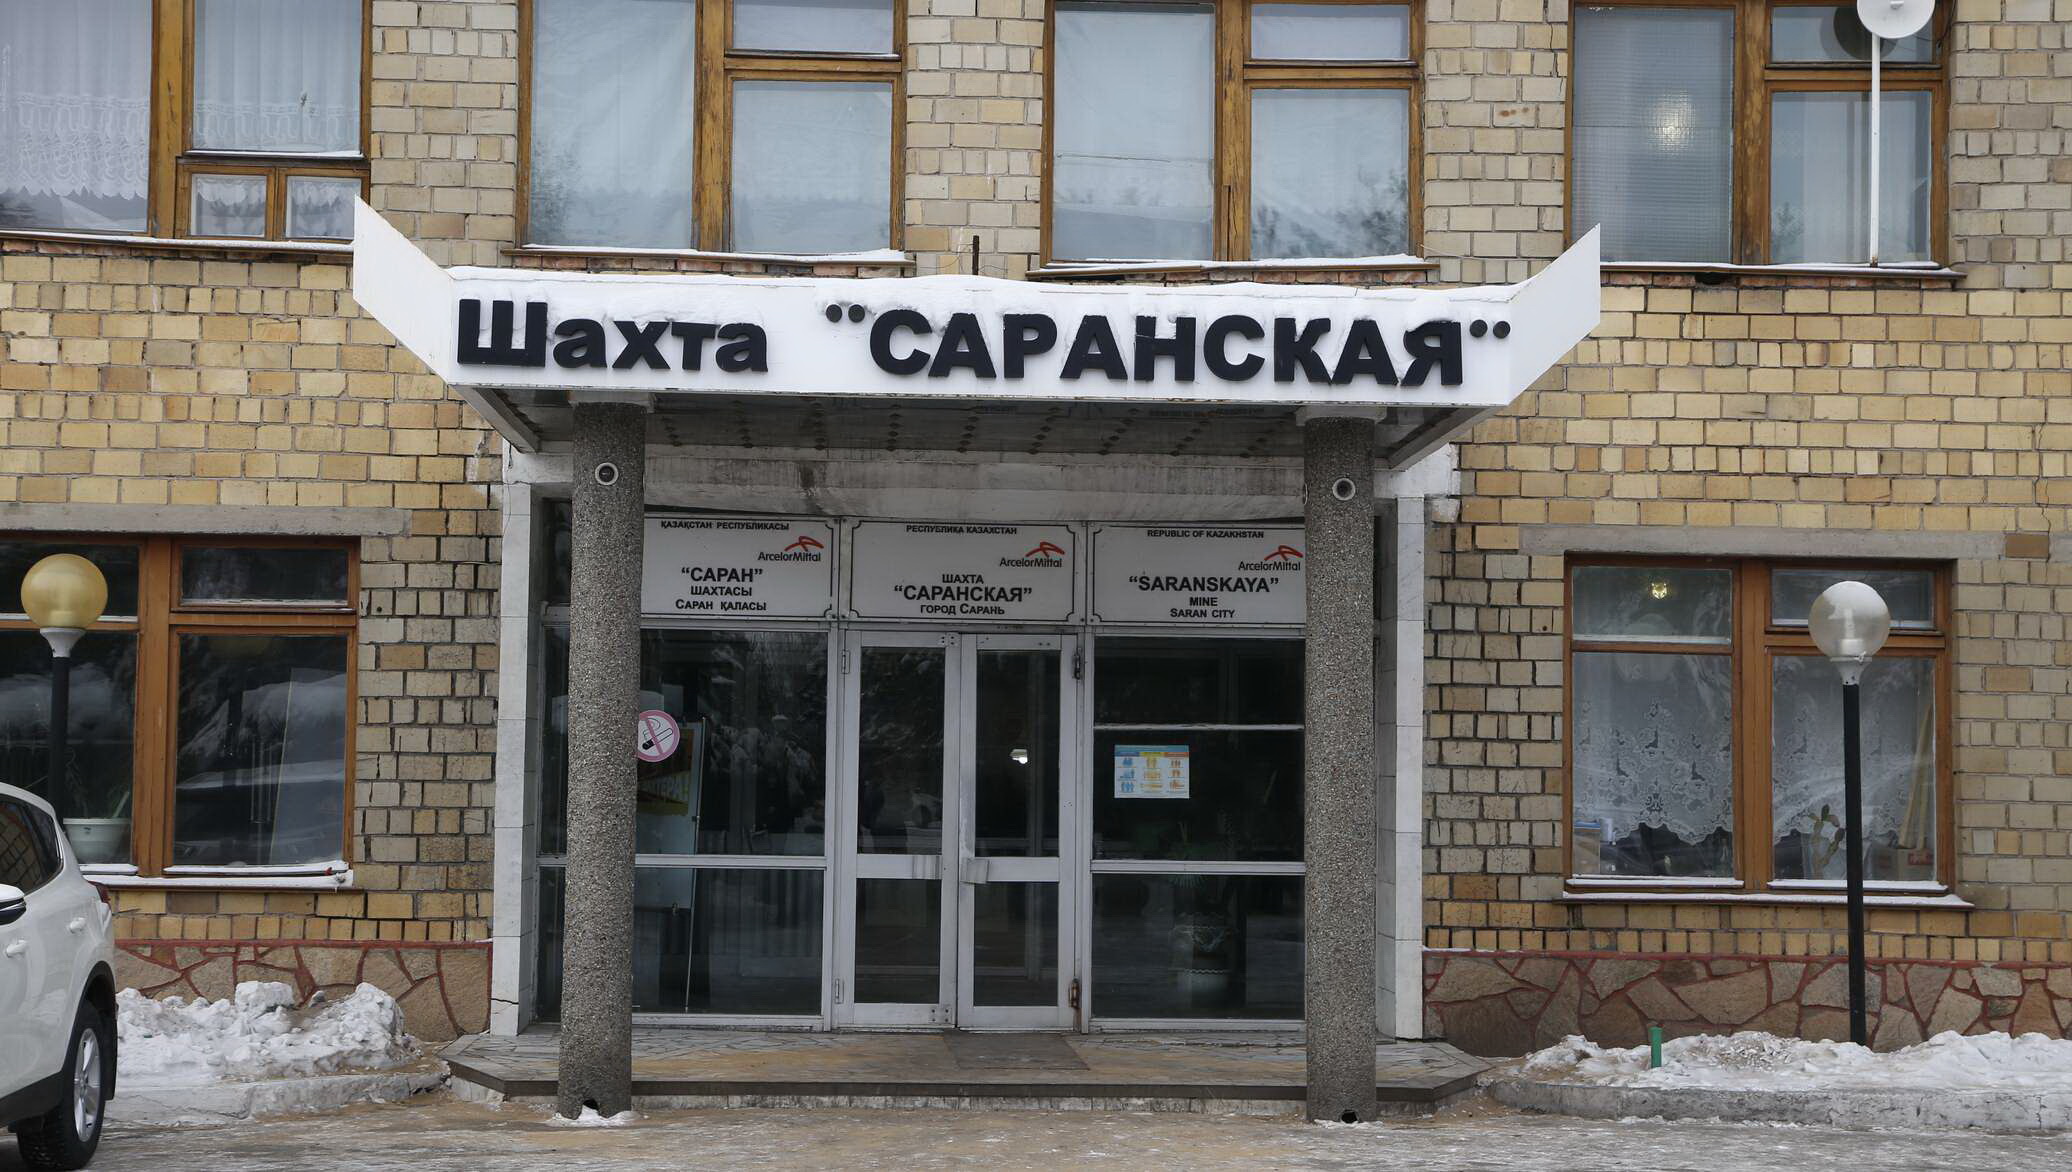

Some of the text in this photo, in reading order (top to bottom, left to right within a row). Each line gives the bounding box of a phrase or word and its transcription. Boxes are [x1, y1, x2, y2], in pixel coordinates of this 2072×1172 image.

[457, 298, 768, 373] Шахта
[661, 520, 790, 531] ҚАЗАҚСТАН РЕСПУБЛИКАСЫ
[906, 525, 1017, 535] РЕСПУБЛИКА КАЗАХСТАН
[1147, 529, 1264, 539] REPUBLIC OF KAZAKHSTAN
[758, 551, 821, 562] ArcelorMittal
[1000, 557, 1062, 568] ArcelorMittal
[1238, 560, 1301, 571] ArcelorMittal
[942, 574, 984, 584] ШАХТА
[690, 585, 752, 597] ШАХТАСЫ
[1189, 596, 1218, 607] MINE
[1212, 609, 1235, 618] CITY
